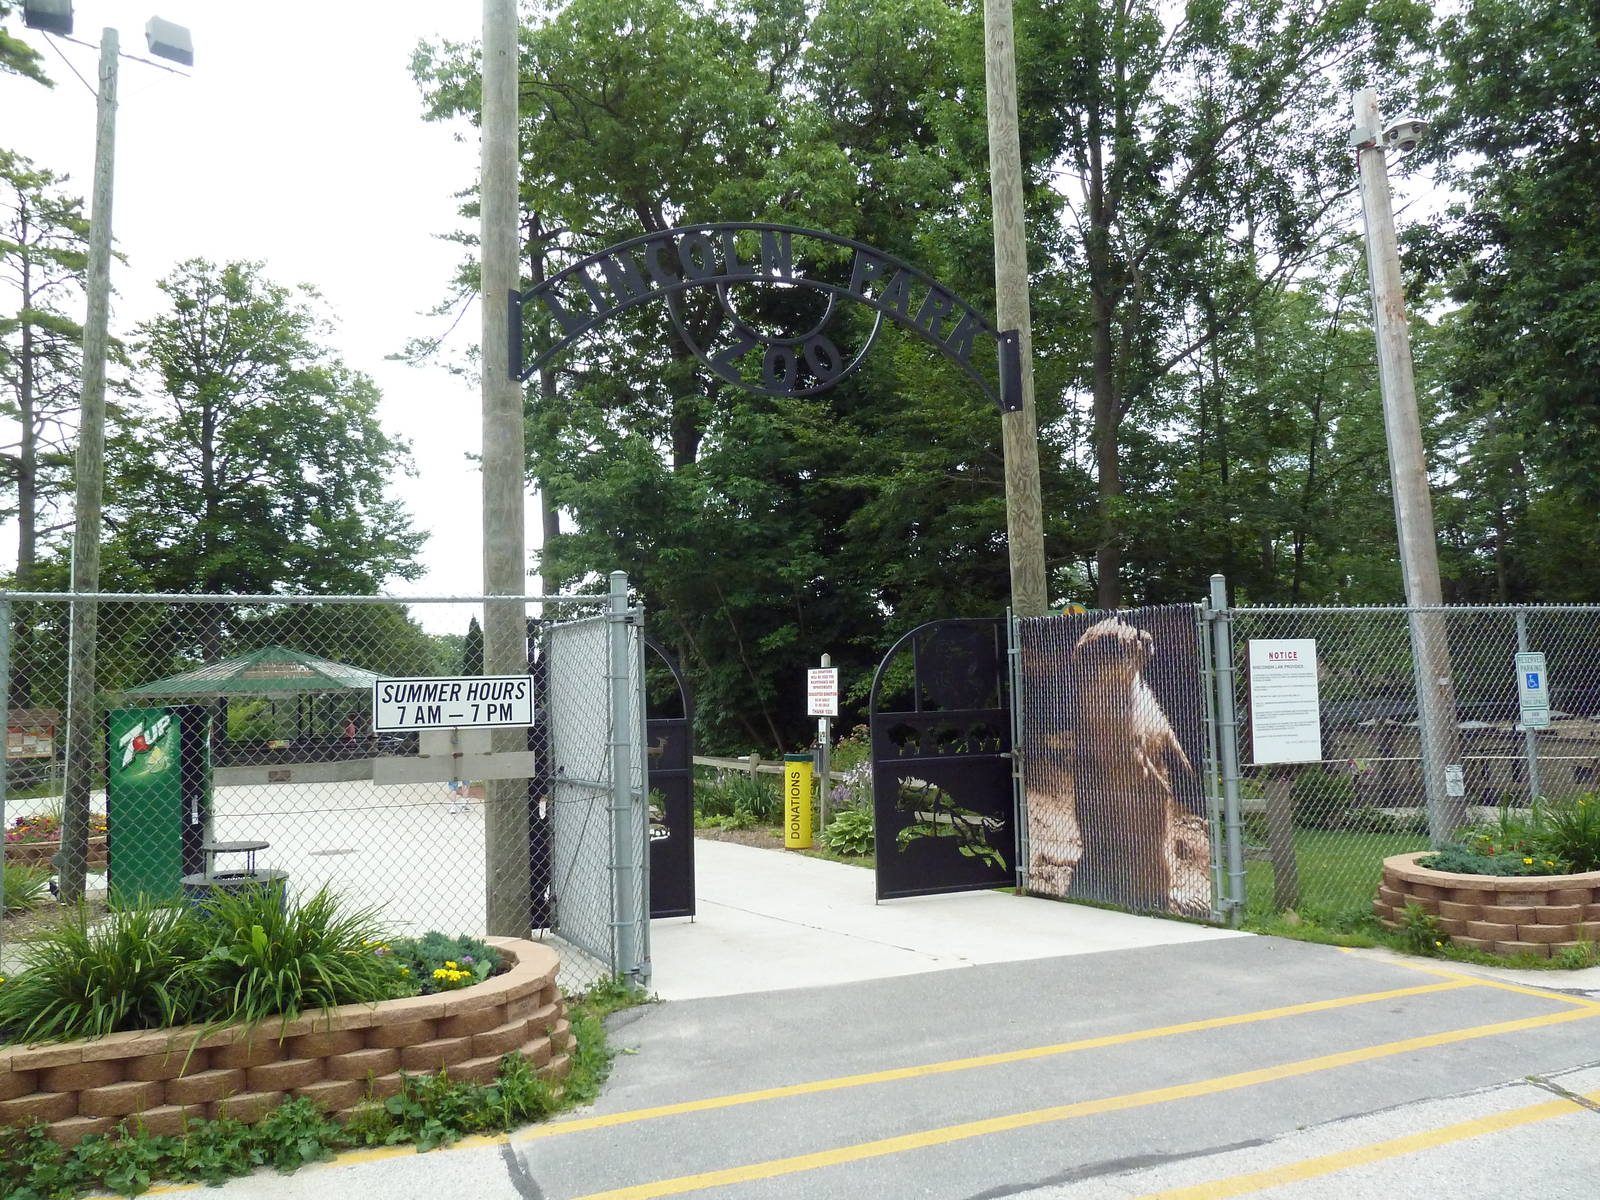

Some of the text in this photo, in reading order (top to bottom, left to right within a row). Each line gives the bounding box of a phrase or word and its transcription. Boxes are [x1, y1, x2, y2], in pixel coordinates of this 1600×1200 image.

[543, 231, 989, 361] LINCOLN PARK
[711, 330, 844, 391] ZOO
[1268, 651, 1298, 660] NOTICE
[382, 681, 526, 704] SUMMER HOURS
[397, 706, 407, 725] 7
[414, 705, 441, 724] AM
[471, 704, 480, 722] 7
[487, 703, 512, 722] PM
[791, 771, 800, 840] DONATIONS
